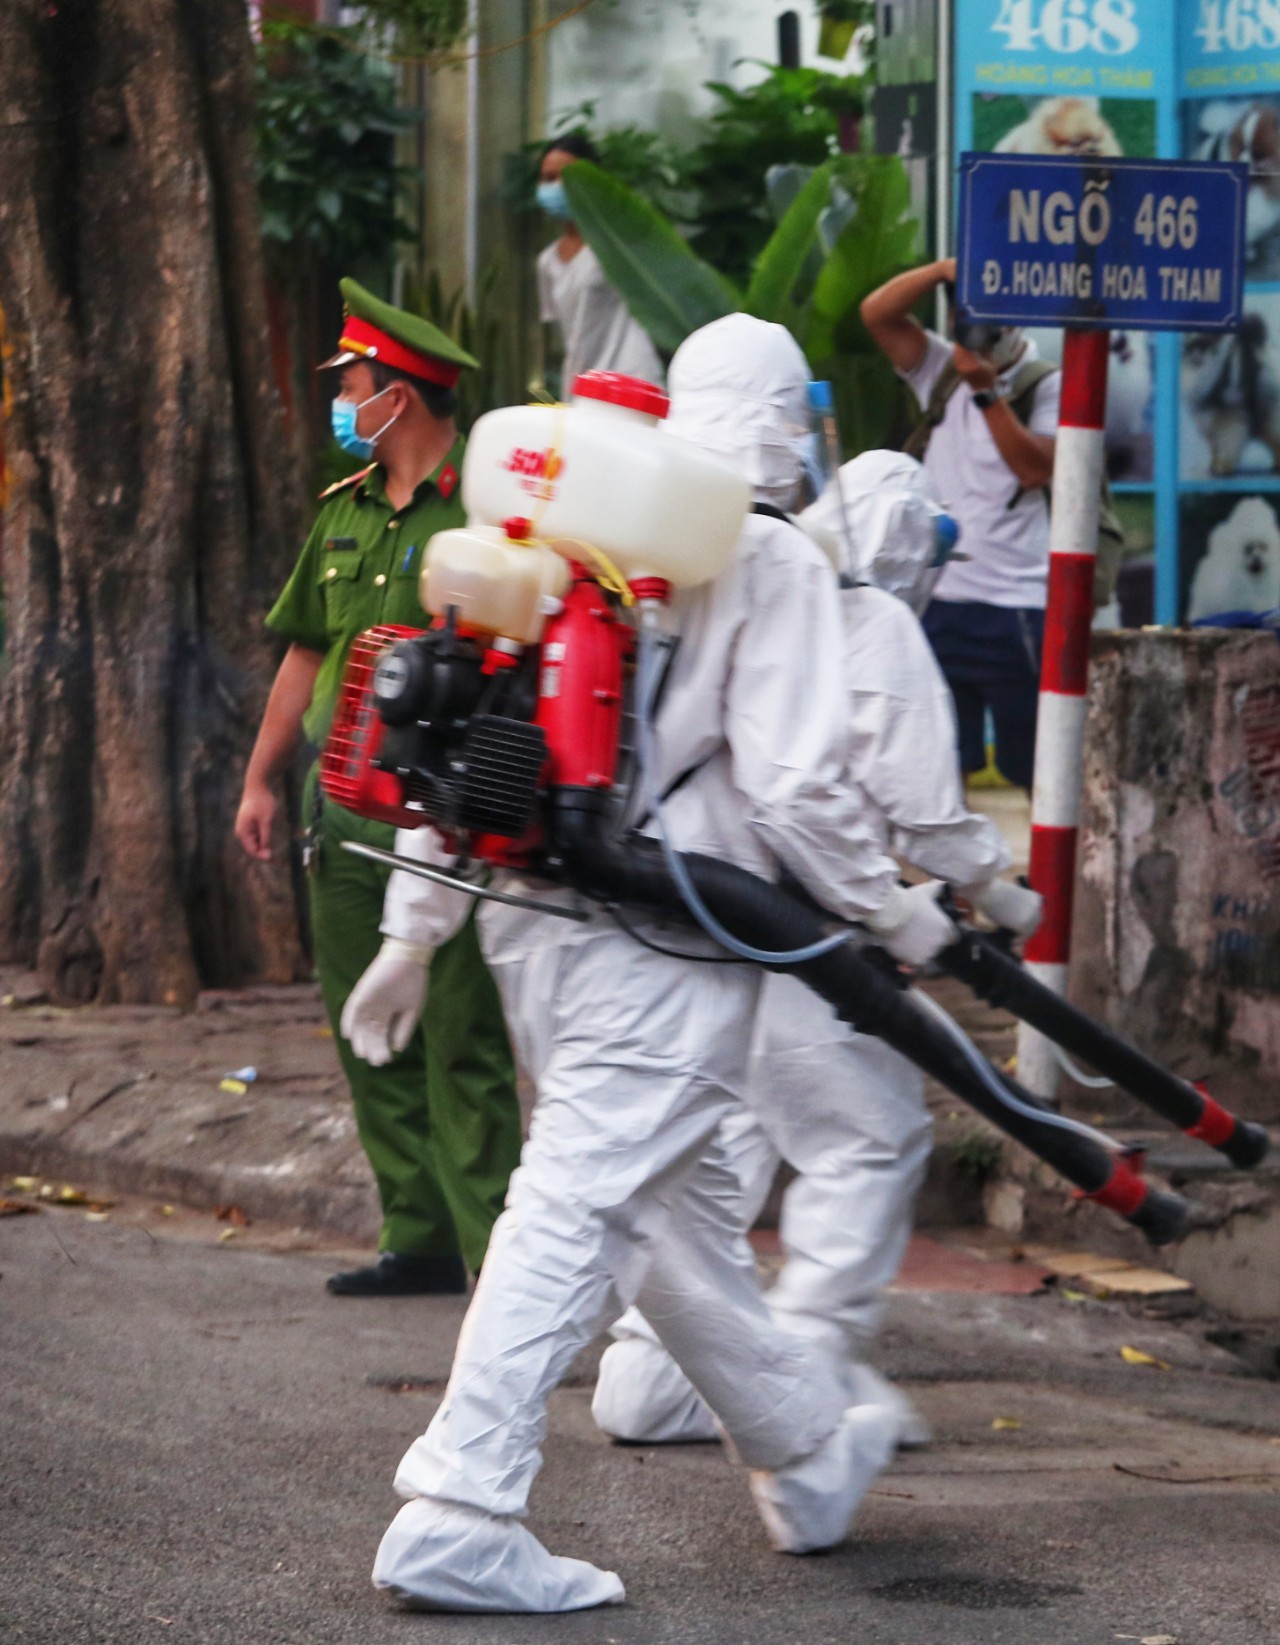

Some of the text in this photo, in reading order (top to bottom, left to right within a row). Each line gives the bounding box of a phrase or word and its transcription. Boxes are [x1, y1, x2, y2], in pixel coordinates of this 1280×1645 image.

[990, 0, 1140, 55] 468
[1008, 179, 1199, 250] NGÕ 466
[1102, 265, 1146, 301] HOA
[1158, 267, 1221, 303] THAM
